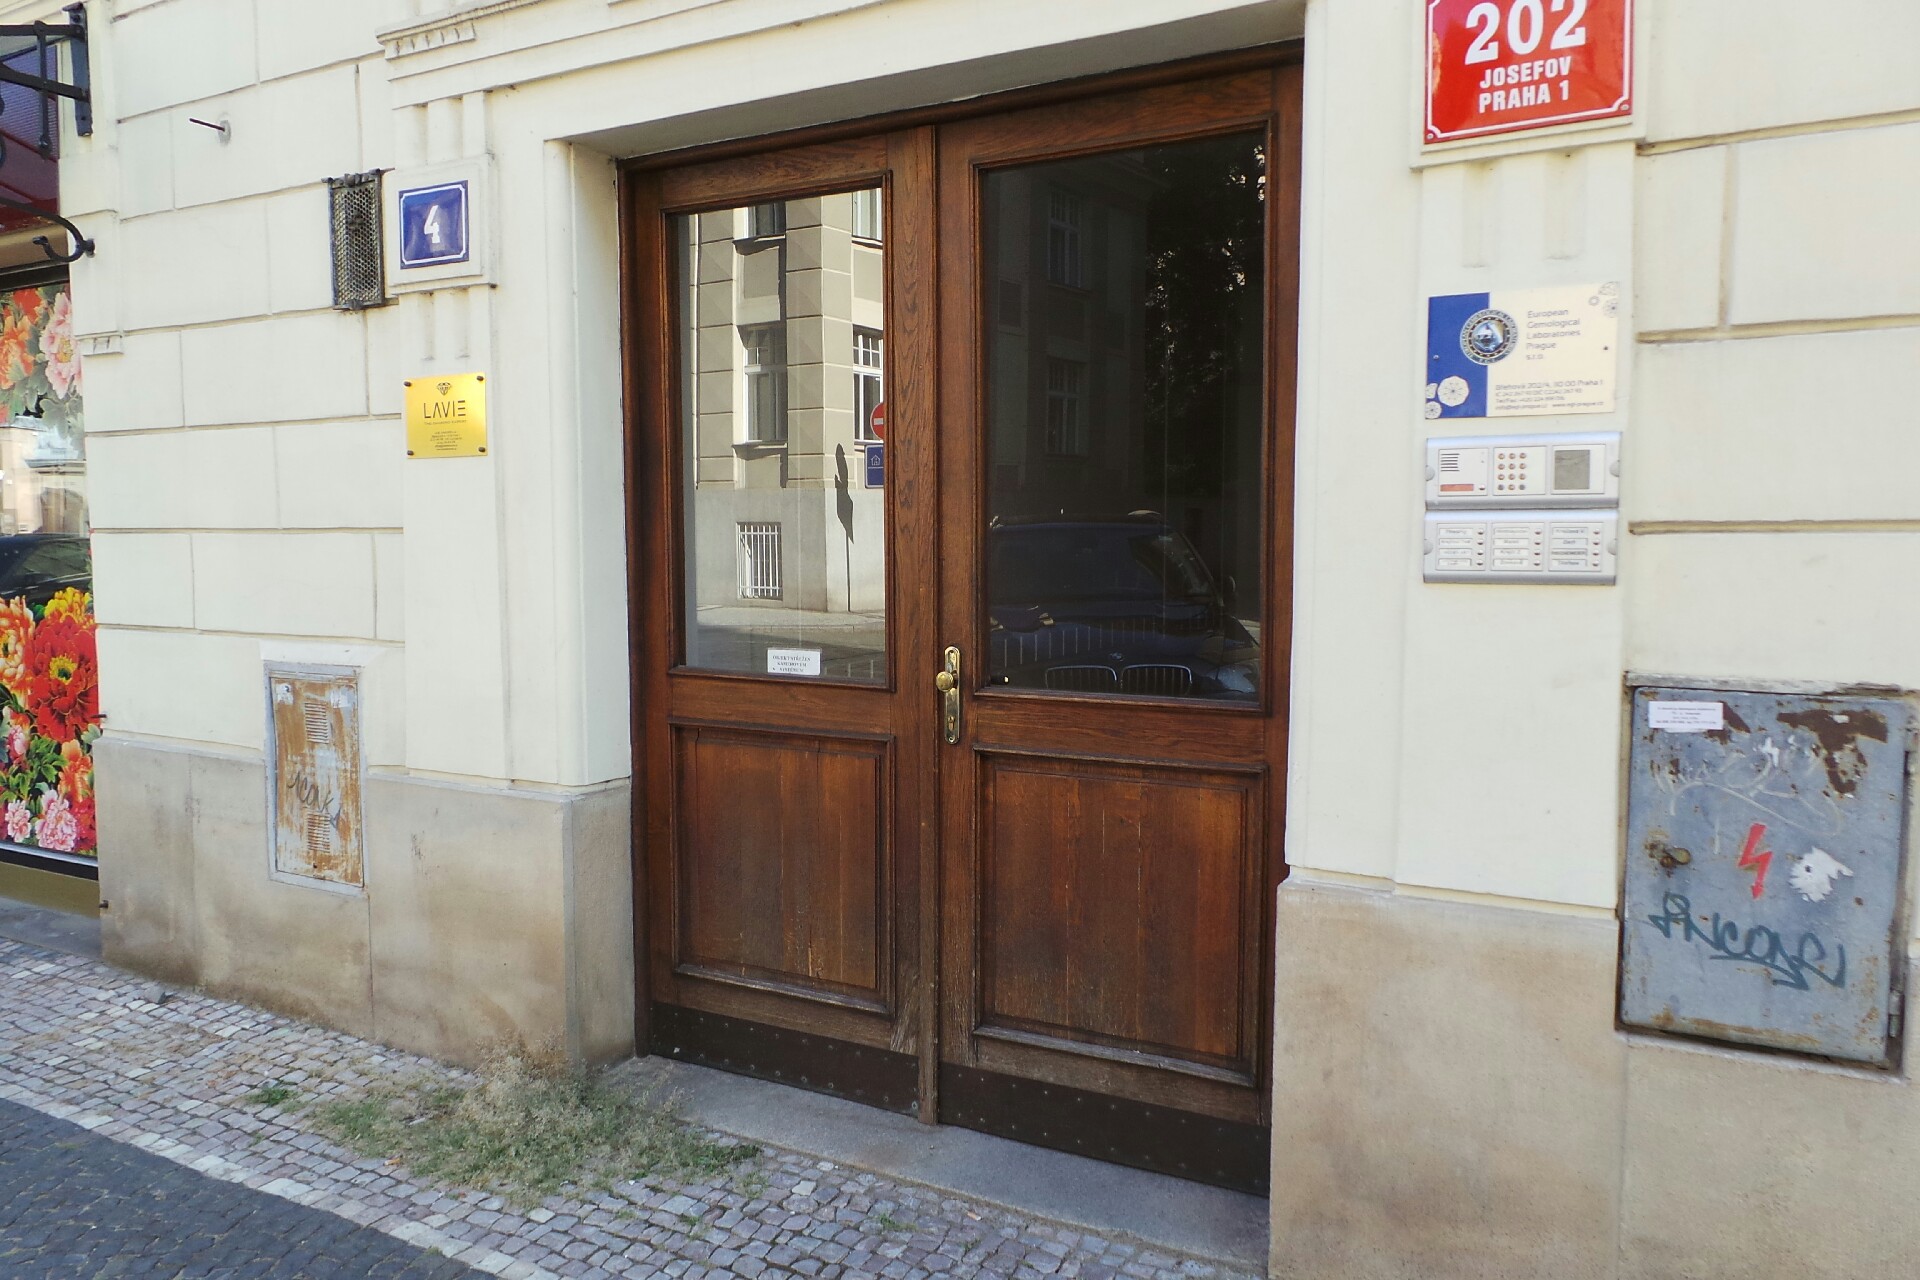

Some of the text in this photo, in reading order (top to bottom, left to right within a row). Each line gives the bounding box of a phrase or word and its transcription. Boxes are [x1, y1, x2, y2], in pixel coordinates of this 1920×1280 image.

[1464, 0, 1588, 65] 202
[1479, 55, 1572, 89] JOSEFOV
[1478, 79, 1570, 114] PRAHA 1
[423, 204, 441, 244] 4
[1527, 309, 1569, 318] European
[1527, 318, 1581, 329] Gemological
[1526, 330, 1581, 340] Laboratories
[1526, 342, 1556, 351] Prague
[423, 400, 466, 419] LAVIE
